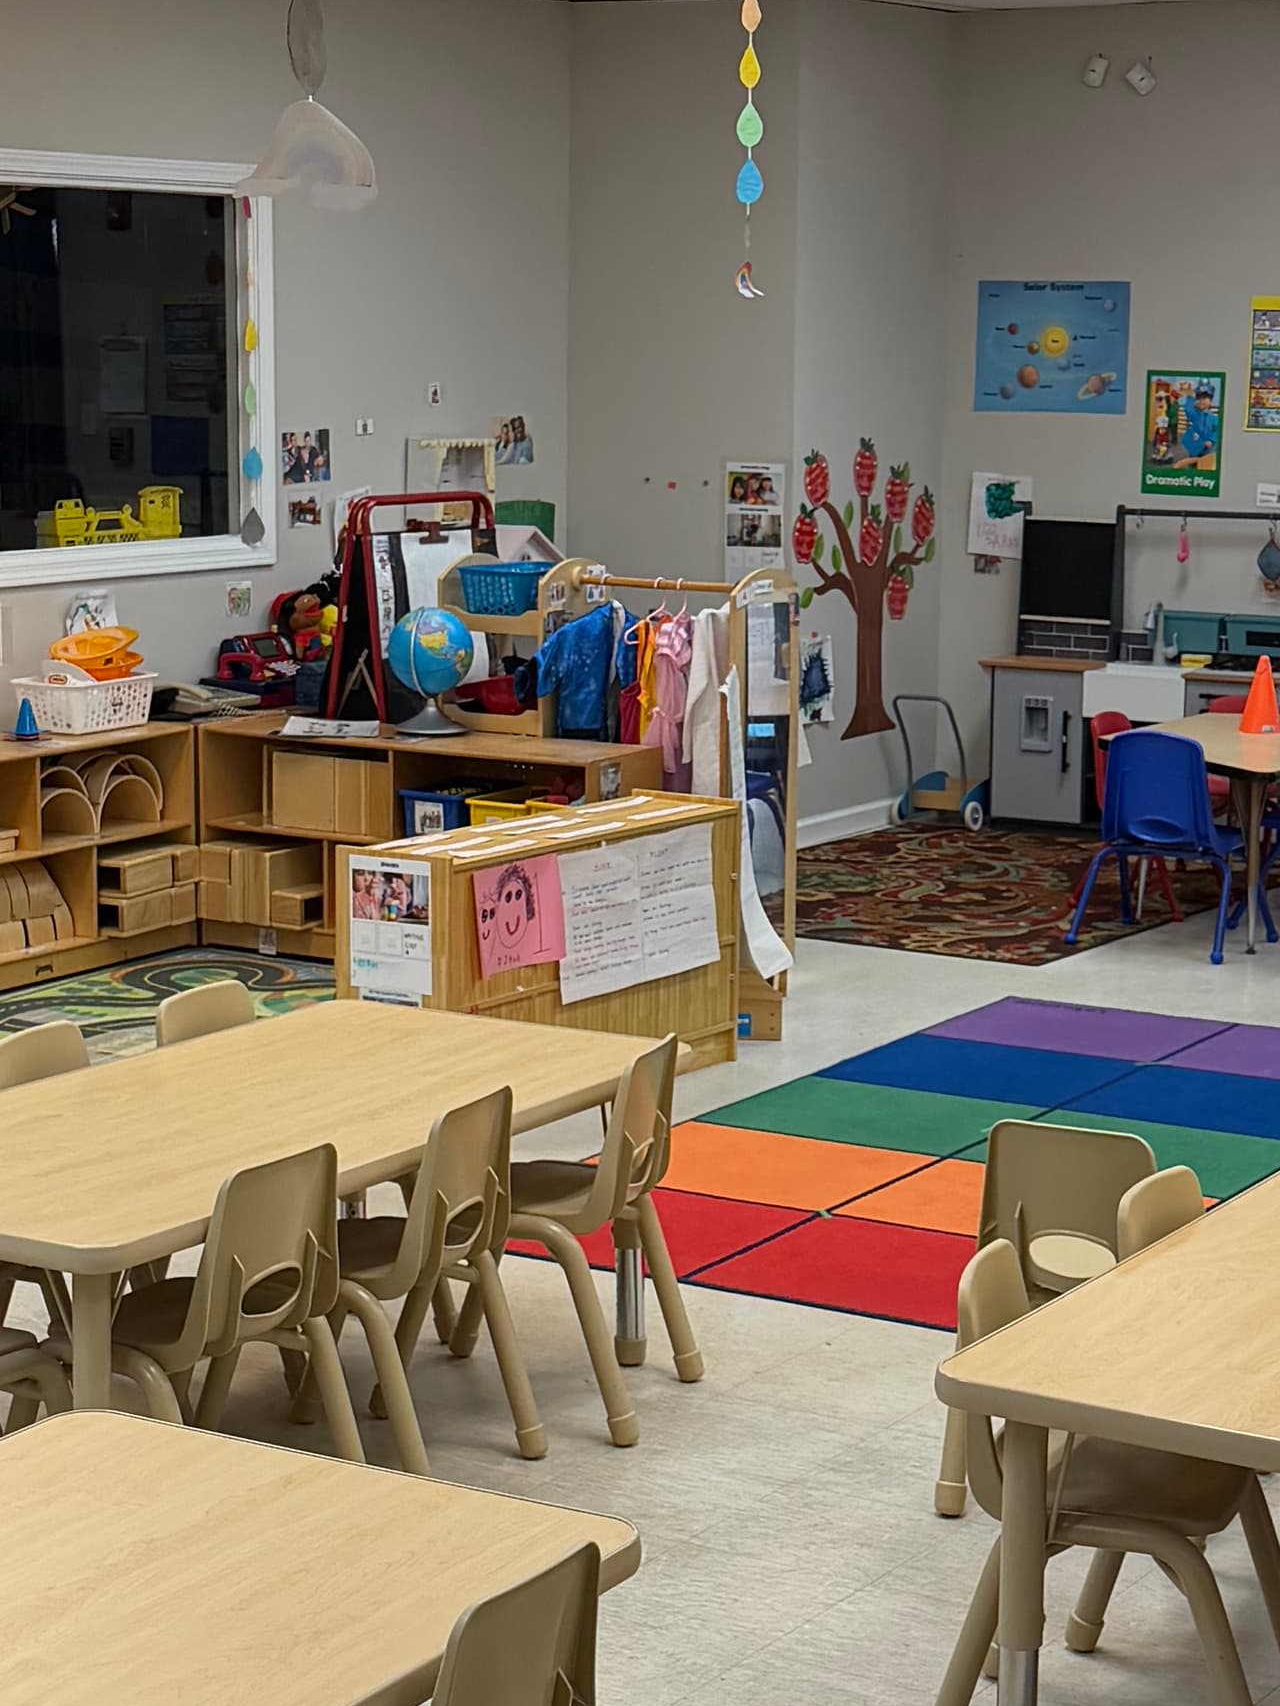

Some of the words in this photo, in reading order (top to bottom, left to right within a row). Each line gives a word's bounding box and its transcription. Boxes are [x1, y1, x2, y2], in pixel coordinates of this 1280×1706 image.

[1023, 283, 1047, 291] Solar
[1050, 283, 1085, 292] System
[1145, 474, 1192, 486] Dramatic
[1193, 476, 1216, 490] Play
